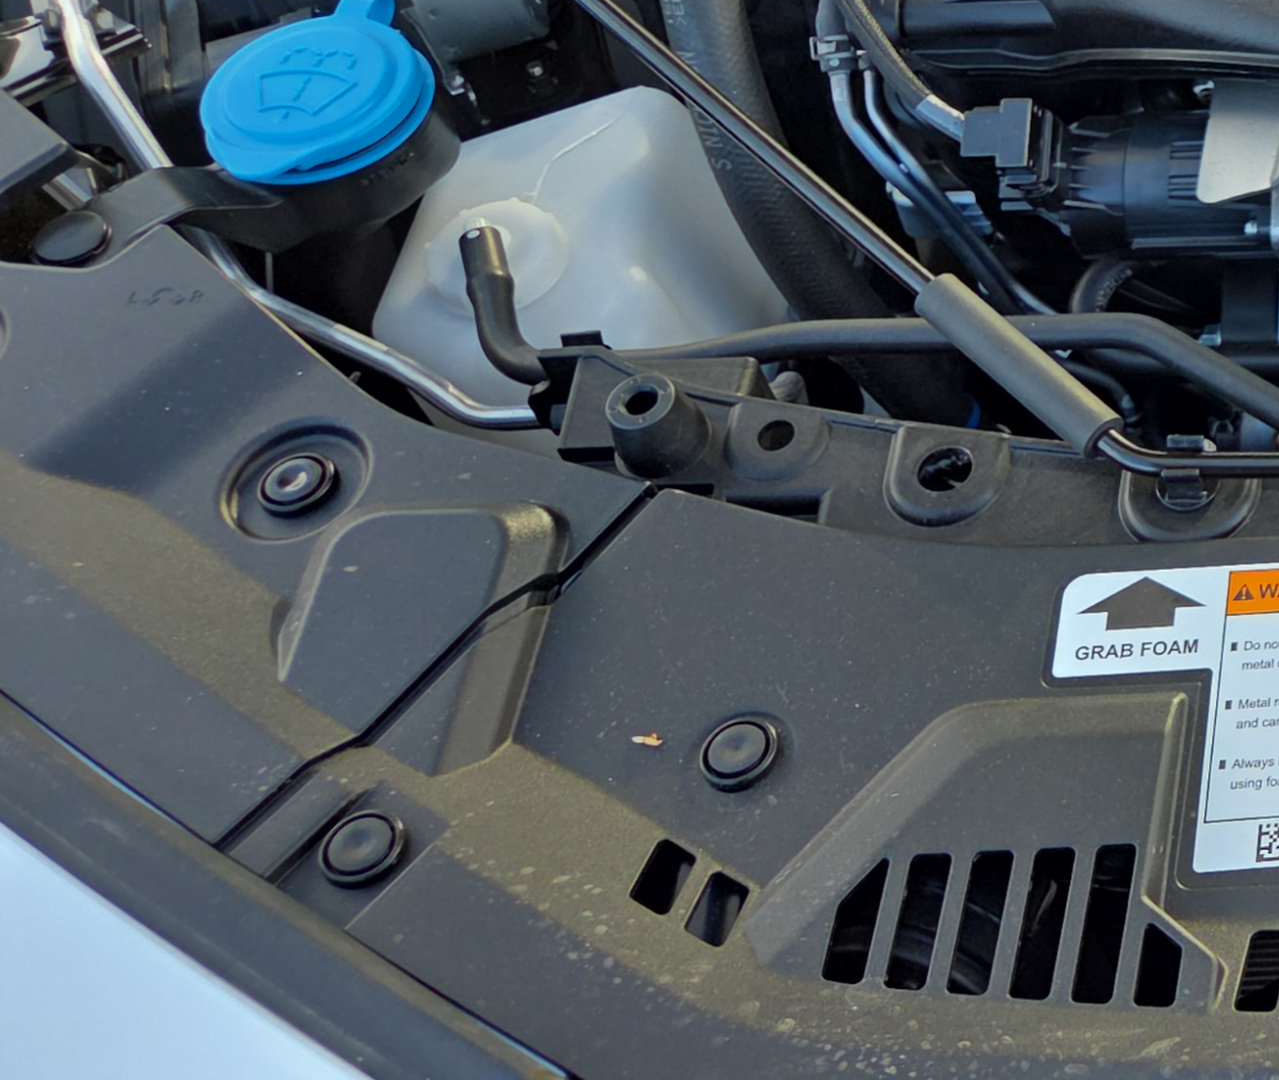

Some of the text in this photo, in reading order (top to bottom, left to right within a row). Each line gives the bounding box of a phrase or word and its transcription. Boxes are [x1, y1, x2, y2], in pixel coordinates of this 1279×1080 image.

[1075, 638, 1199, 661] GRAB FOAM
[1243, 640, 1261, 651] Do
[1241, 658, 1274, 670] metal
[1237, 697, 1271, 709] Metal
[1235, 718, 1259, 729] and
[1231, 756, 1275, 770] Always
[1230, 777, 1262, 791] using
